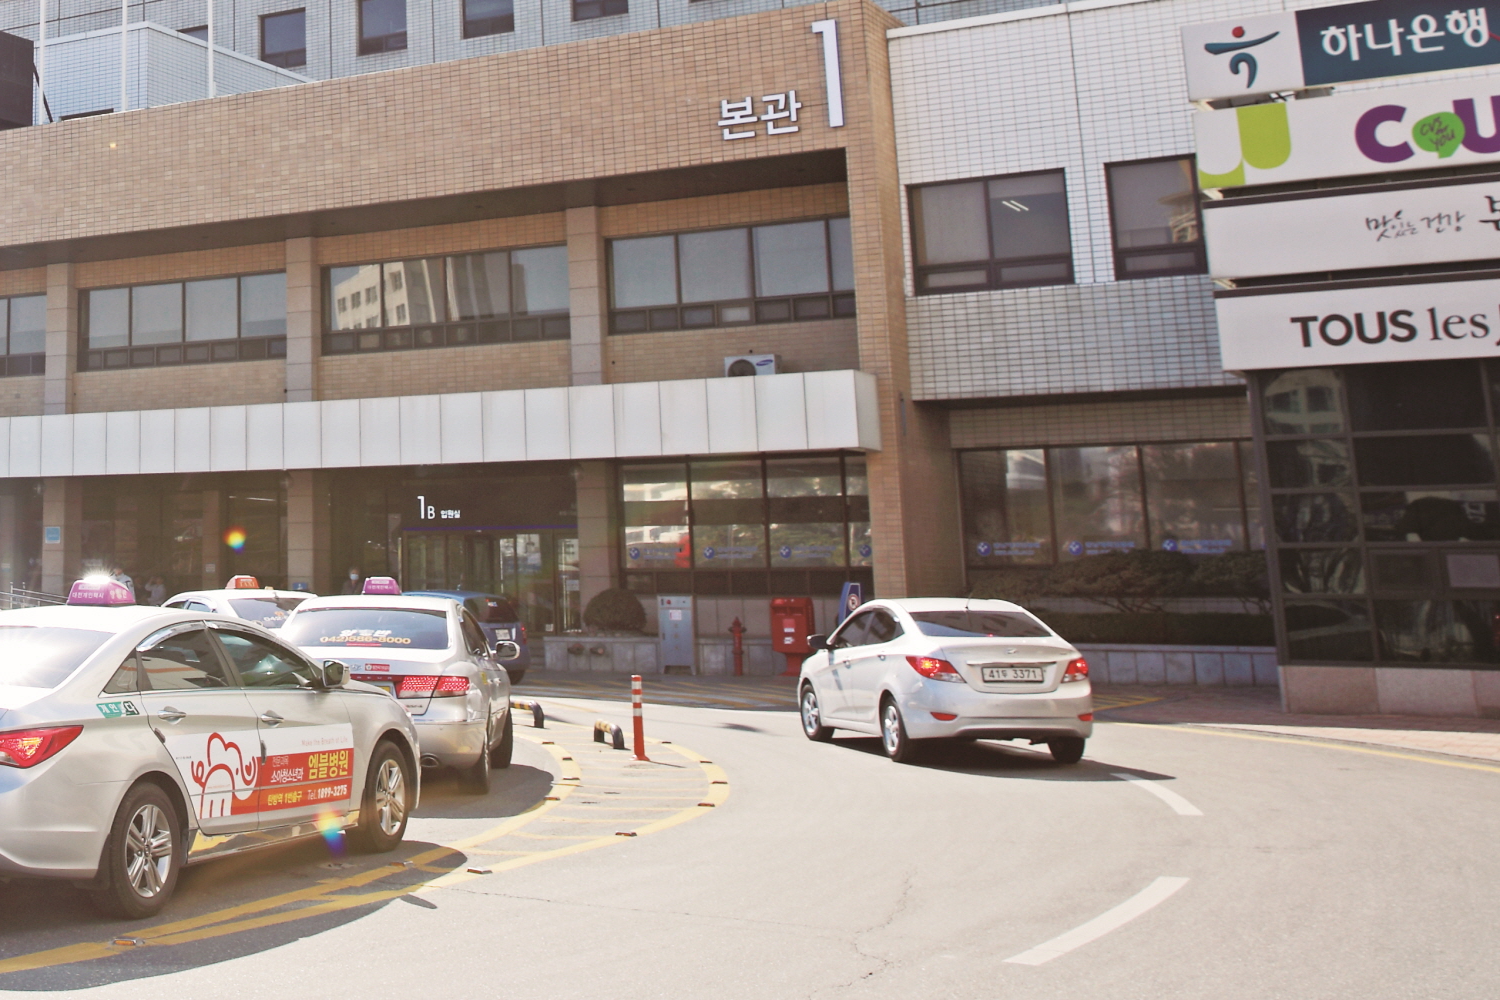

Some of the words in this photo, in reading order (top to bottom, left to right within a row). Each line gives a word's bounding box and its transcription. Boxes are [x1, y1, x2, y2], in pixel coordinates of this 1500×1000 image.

[1320, 7, 1489, 61] 하나은행
[718, 90, 802, 141] 본관
[811, 19, 845, 128] 1
[1290, 309, 1418, 347] TOUS
[1427, 307, 1490, 341] les
[417, 495, 435, 519] 1B
[1012, 669, 1037, 679] 3371
[308, 750, 349, 780] 엠블병원
